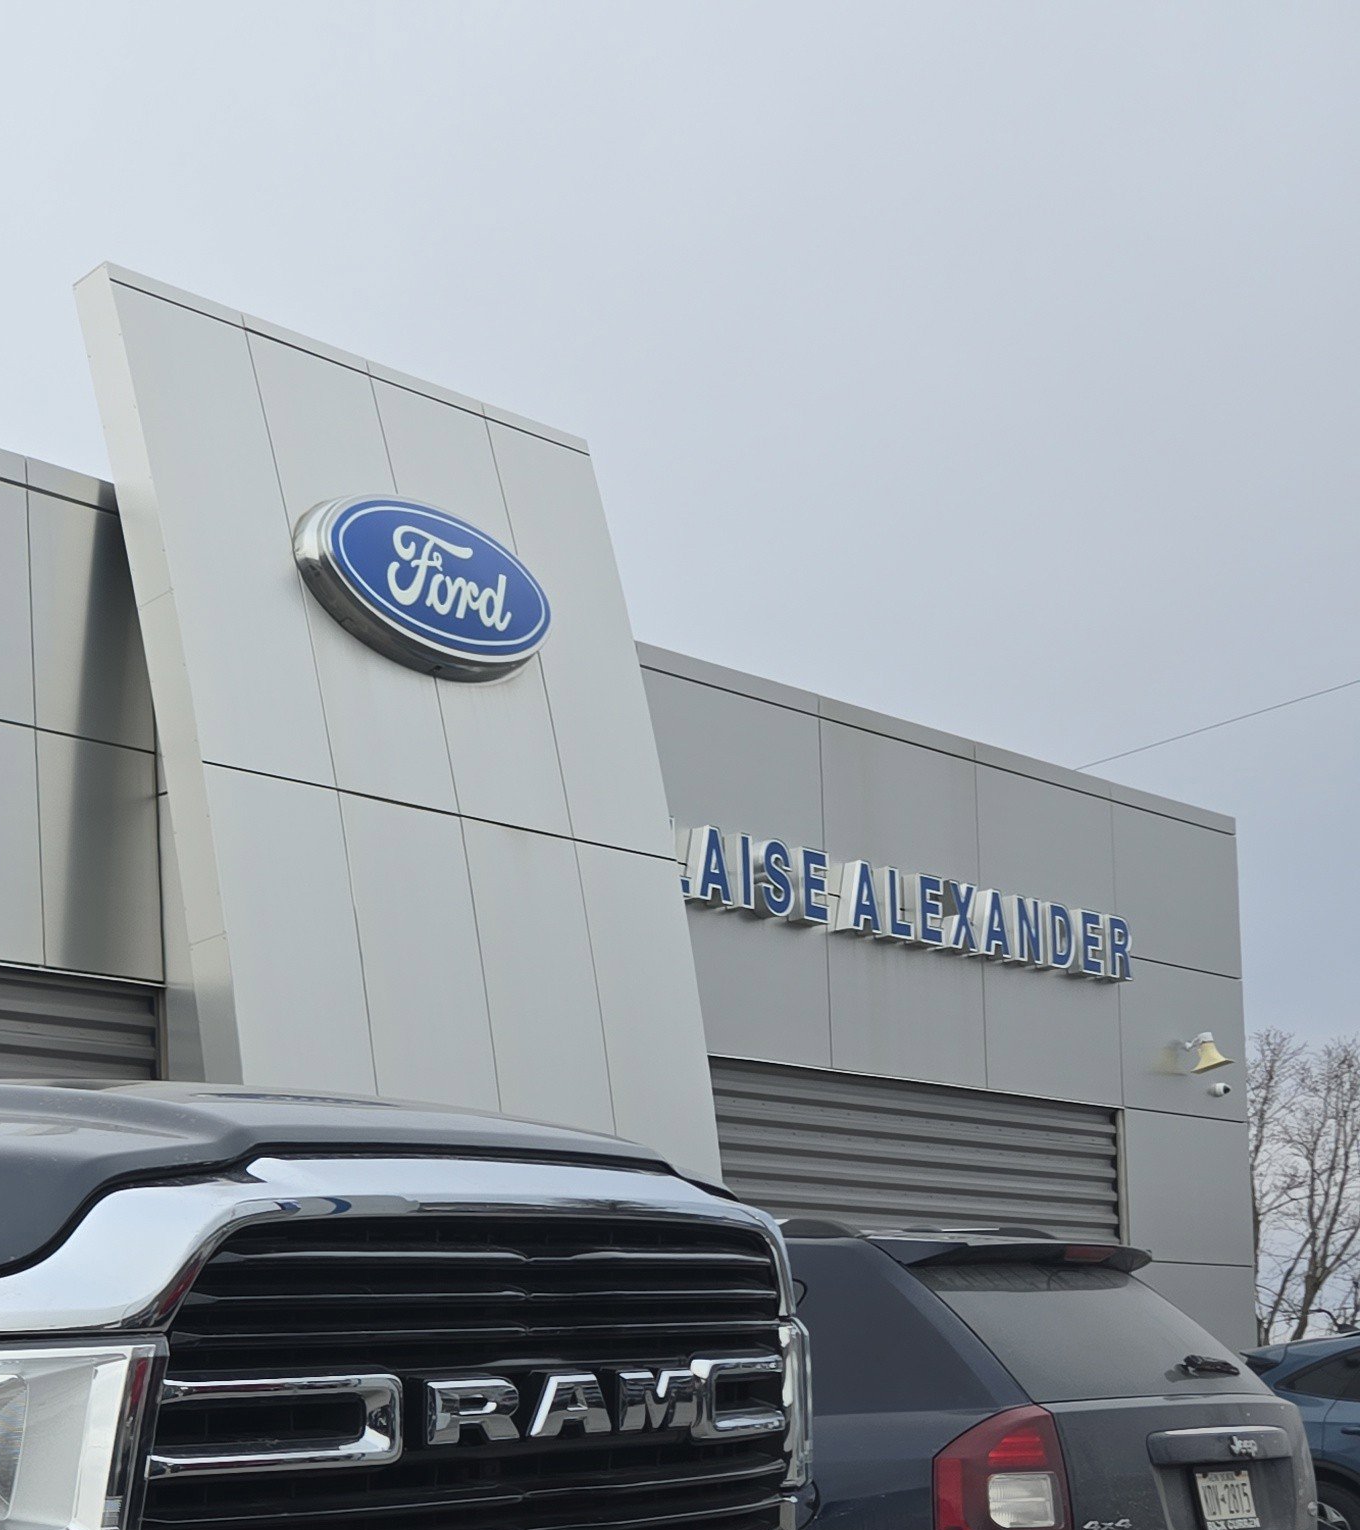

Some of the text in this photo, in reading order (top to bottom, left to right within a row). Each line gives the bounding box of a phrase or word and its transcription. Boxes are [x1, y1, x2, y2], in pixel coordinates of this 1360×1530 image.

[387, 525, 513, 632] Ford
[842, 860, 1133, 982] ALEXANDER
[424, 1368, 699, 1446] RAM
[1229, 1435, 1258, 1457] Jeep
